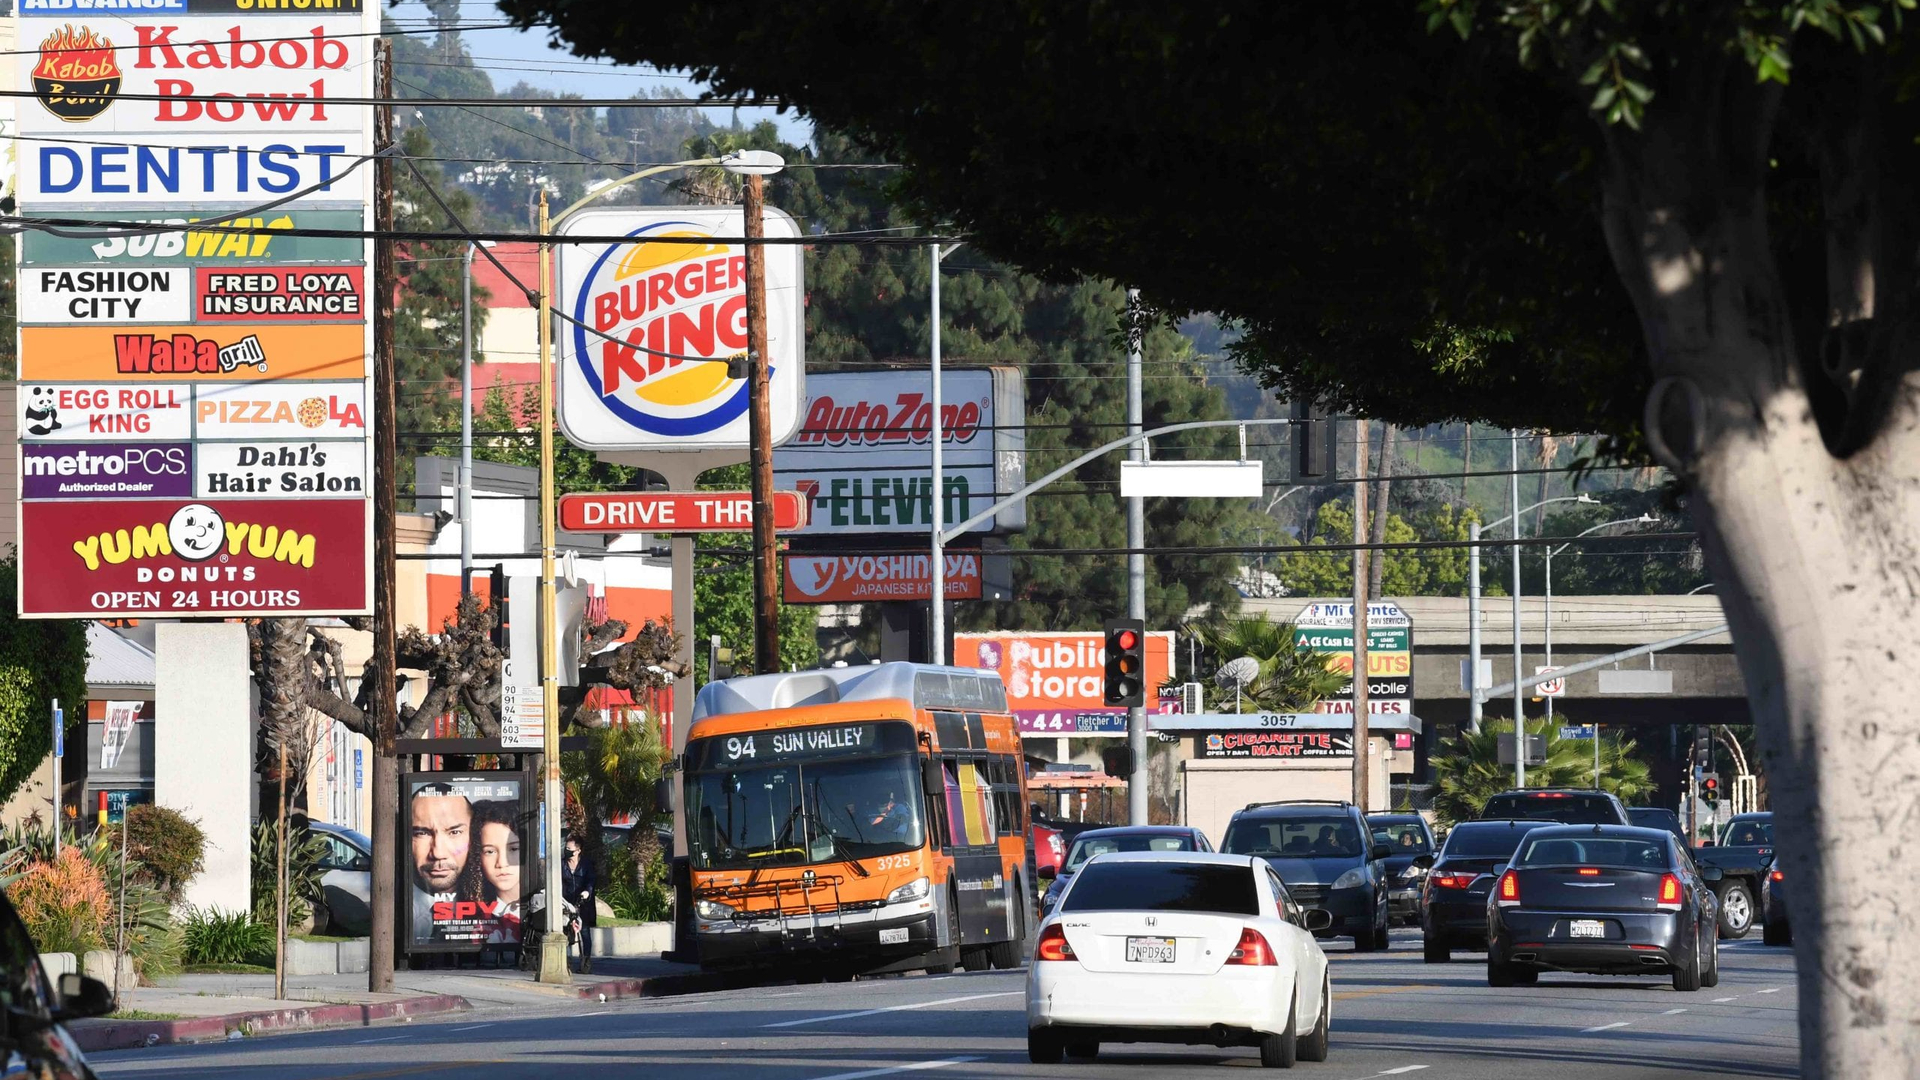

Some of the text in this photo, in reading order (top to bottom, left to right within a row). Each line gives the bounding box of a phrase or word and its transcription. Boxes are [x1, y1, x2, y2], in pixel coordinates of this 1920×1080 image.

[133, 25, 349, 69] Kabob
[43, 55, 113, 78] Kabob
[154, 78, 328, 122] Bowl
[39, 144, 345, 193] DENTIST
[92, 214, 294, 260] SUBWAY
[41, 271, 170, 293] FASHION
[210, 273, 353, 292] FRED LOYA
[595, 255, 747, 333] BURGER
[68, 297, 142, 318] CITY
[204, 296, 359, 314] INSURANCE
[114, 334, 266, 373] WaBa grill
[602, 294, 749, 396] KING
[58, 389, 181, 410] EGG ROLL
[197, 395, 365, 428] PIZZA LA
[799, 392, 979, 442] AutoZone
[89, 413, 151, 433] KING
[237, 443, 327, 468] Dahl's
[59, 482, 154, 492] Authorized Dealer
[207, 473, 362, 494] Hair Salon
[583, 500, 753, 524] DRIVE THR
[73, 522, 316, 570] YUM YUM
[137, 566, 257, 582] DONUTS
[852, 582, 968, 595] JAPANESE KITHEN
[91, 589, 301, 609] OPEN 24 HOURS
[1325, 605, 1343, 616] Mi
[504, 686, 516, 694] 90
[504, 696, 515, 704] 91
[505, 706, 515, 714] 94
[502, 716, 513, 724] 94
[1077, 716, 1123, 725] Fletcher Dr
[1261, 715, 1297, 727] 3057
[502, 726, 519, 734] 603
[502, 736, 519, 744] 794
[727, 727, 863, 760] 94 SUN VALLEY
[1224, 732, 1331, 749] CIGARETTE
[1251, 745, 1303, 756] MART
[107, 793, 130, 802] DIVE
[877, 854, 911, 871] 3925
[434, 892, 457, 902] MY
[433, 901, 498, 920] SPY
[1130, 946, 1173, 959] 7NPD963
